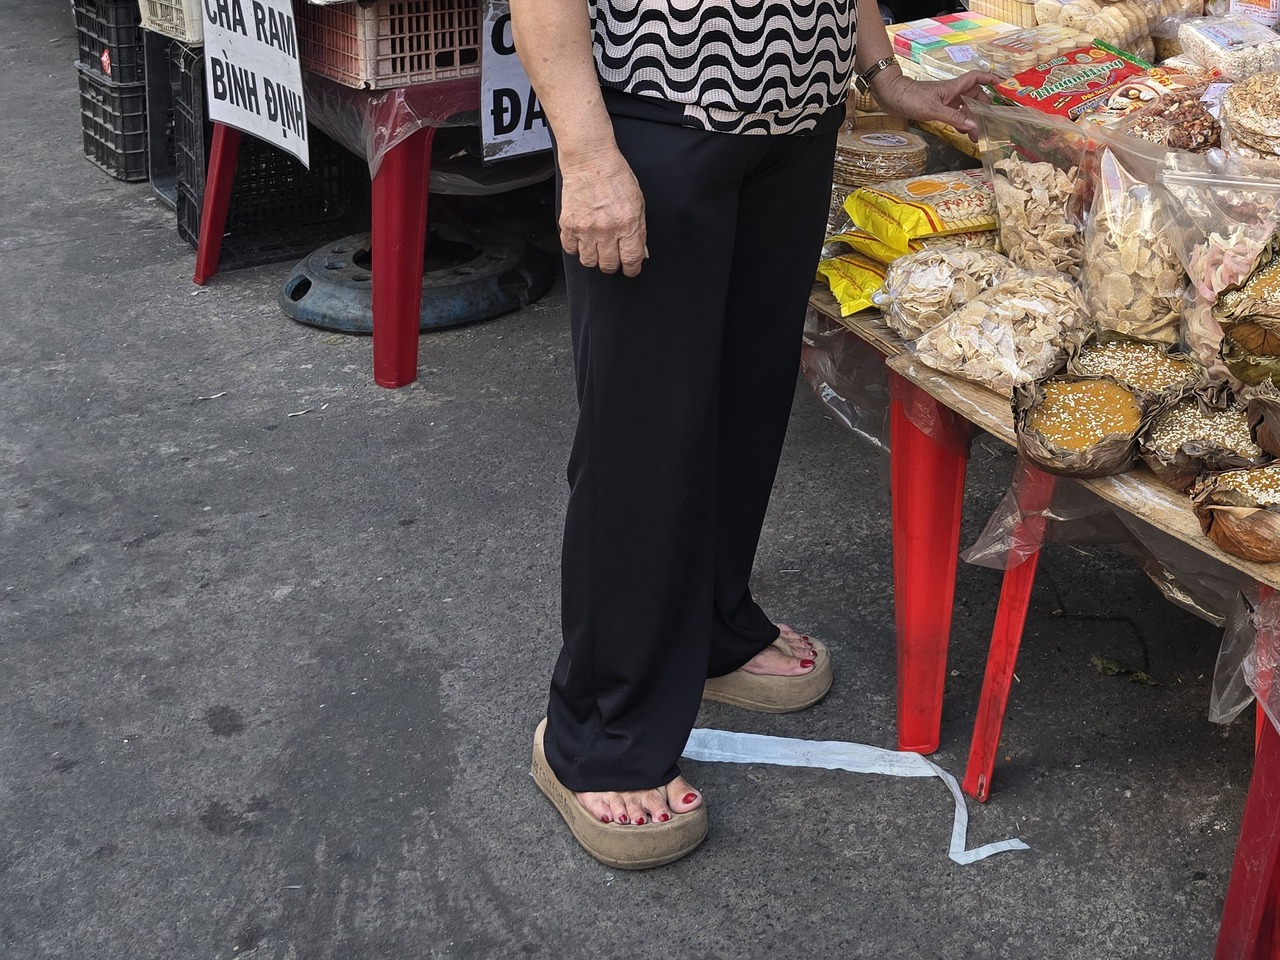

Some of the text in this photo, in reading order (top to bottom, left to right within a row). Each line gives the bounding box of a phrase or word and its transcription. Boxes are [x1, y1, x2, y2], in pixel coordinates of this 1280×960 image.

[252, 0, 297, 60] RAM
[211, 49, 306, 141] BÌNH ĐỊNH
